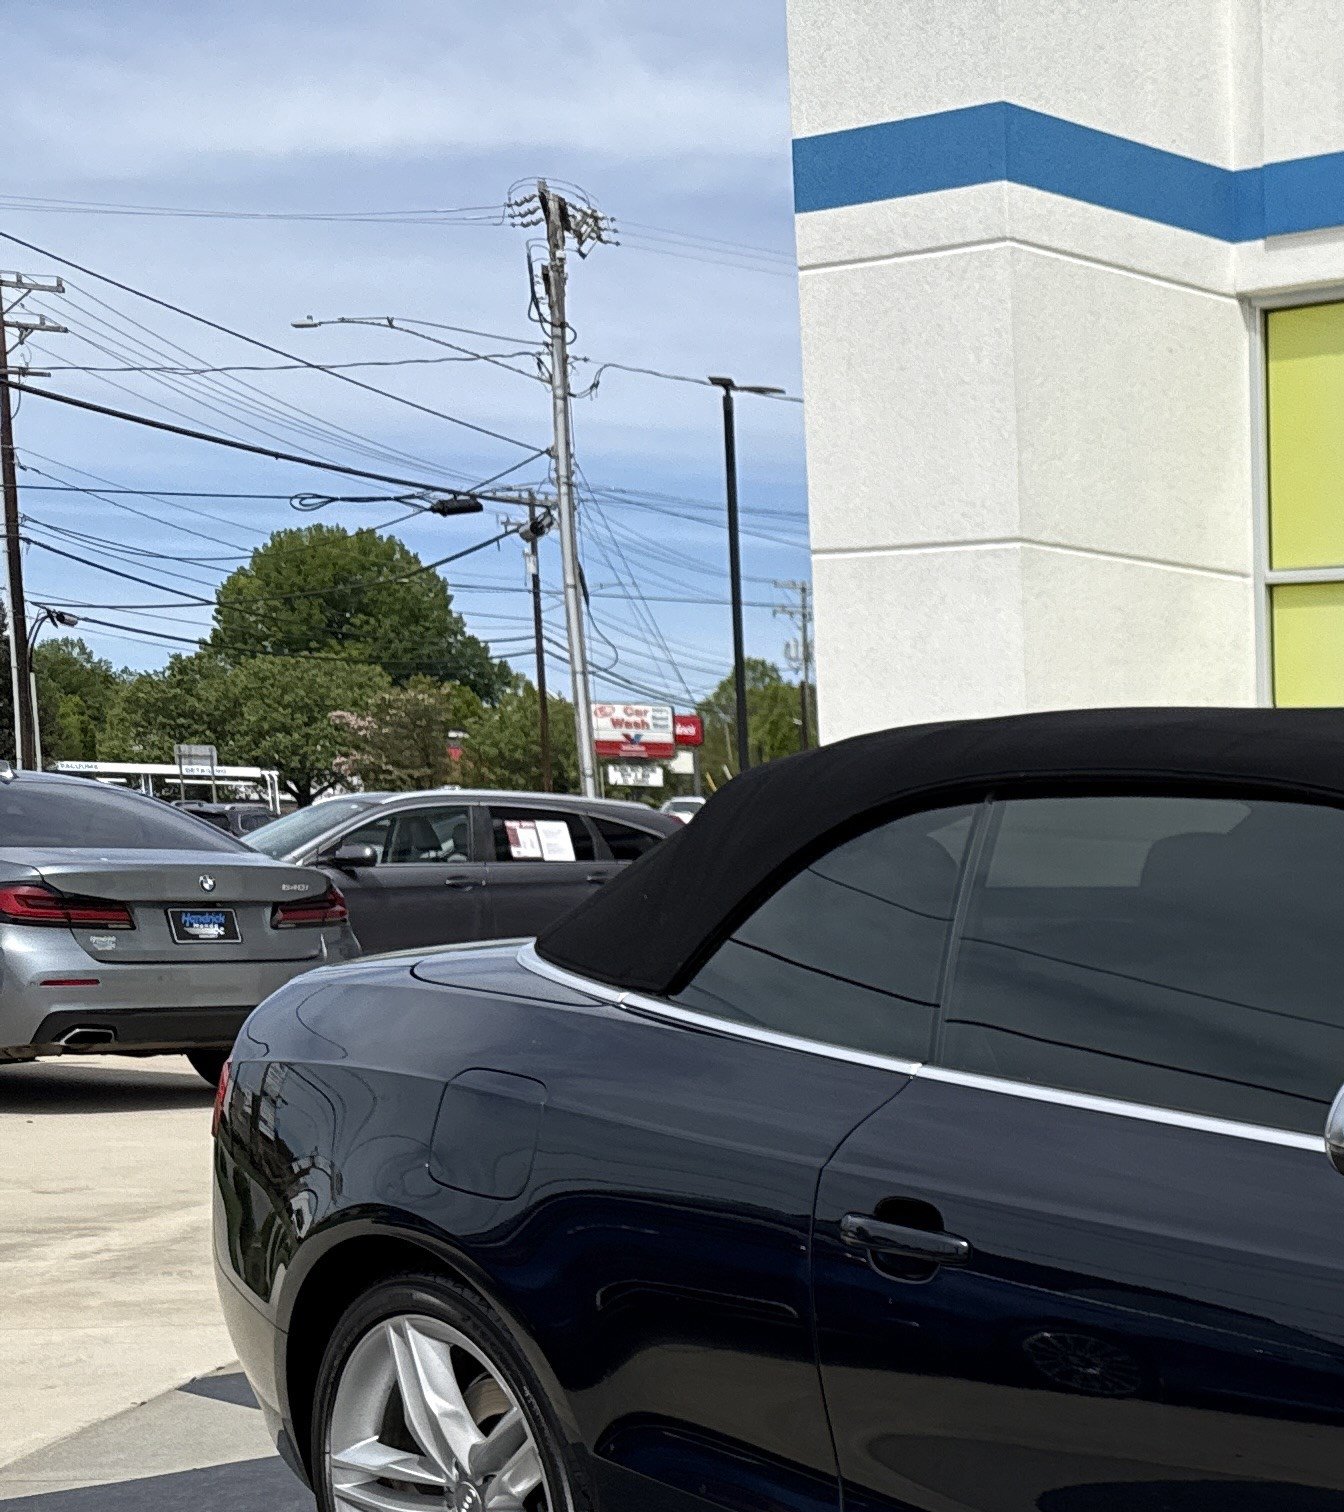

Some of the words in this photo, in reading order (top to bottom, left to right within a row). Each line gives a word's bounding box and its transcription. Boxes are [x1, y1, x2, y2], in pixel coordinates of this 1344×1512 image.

[623, 706, 649, 717] Car
[610, 717, 650, 730] Wash
[182, 912, 225, 927] Hendrick
